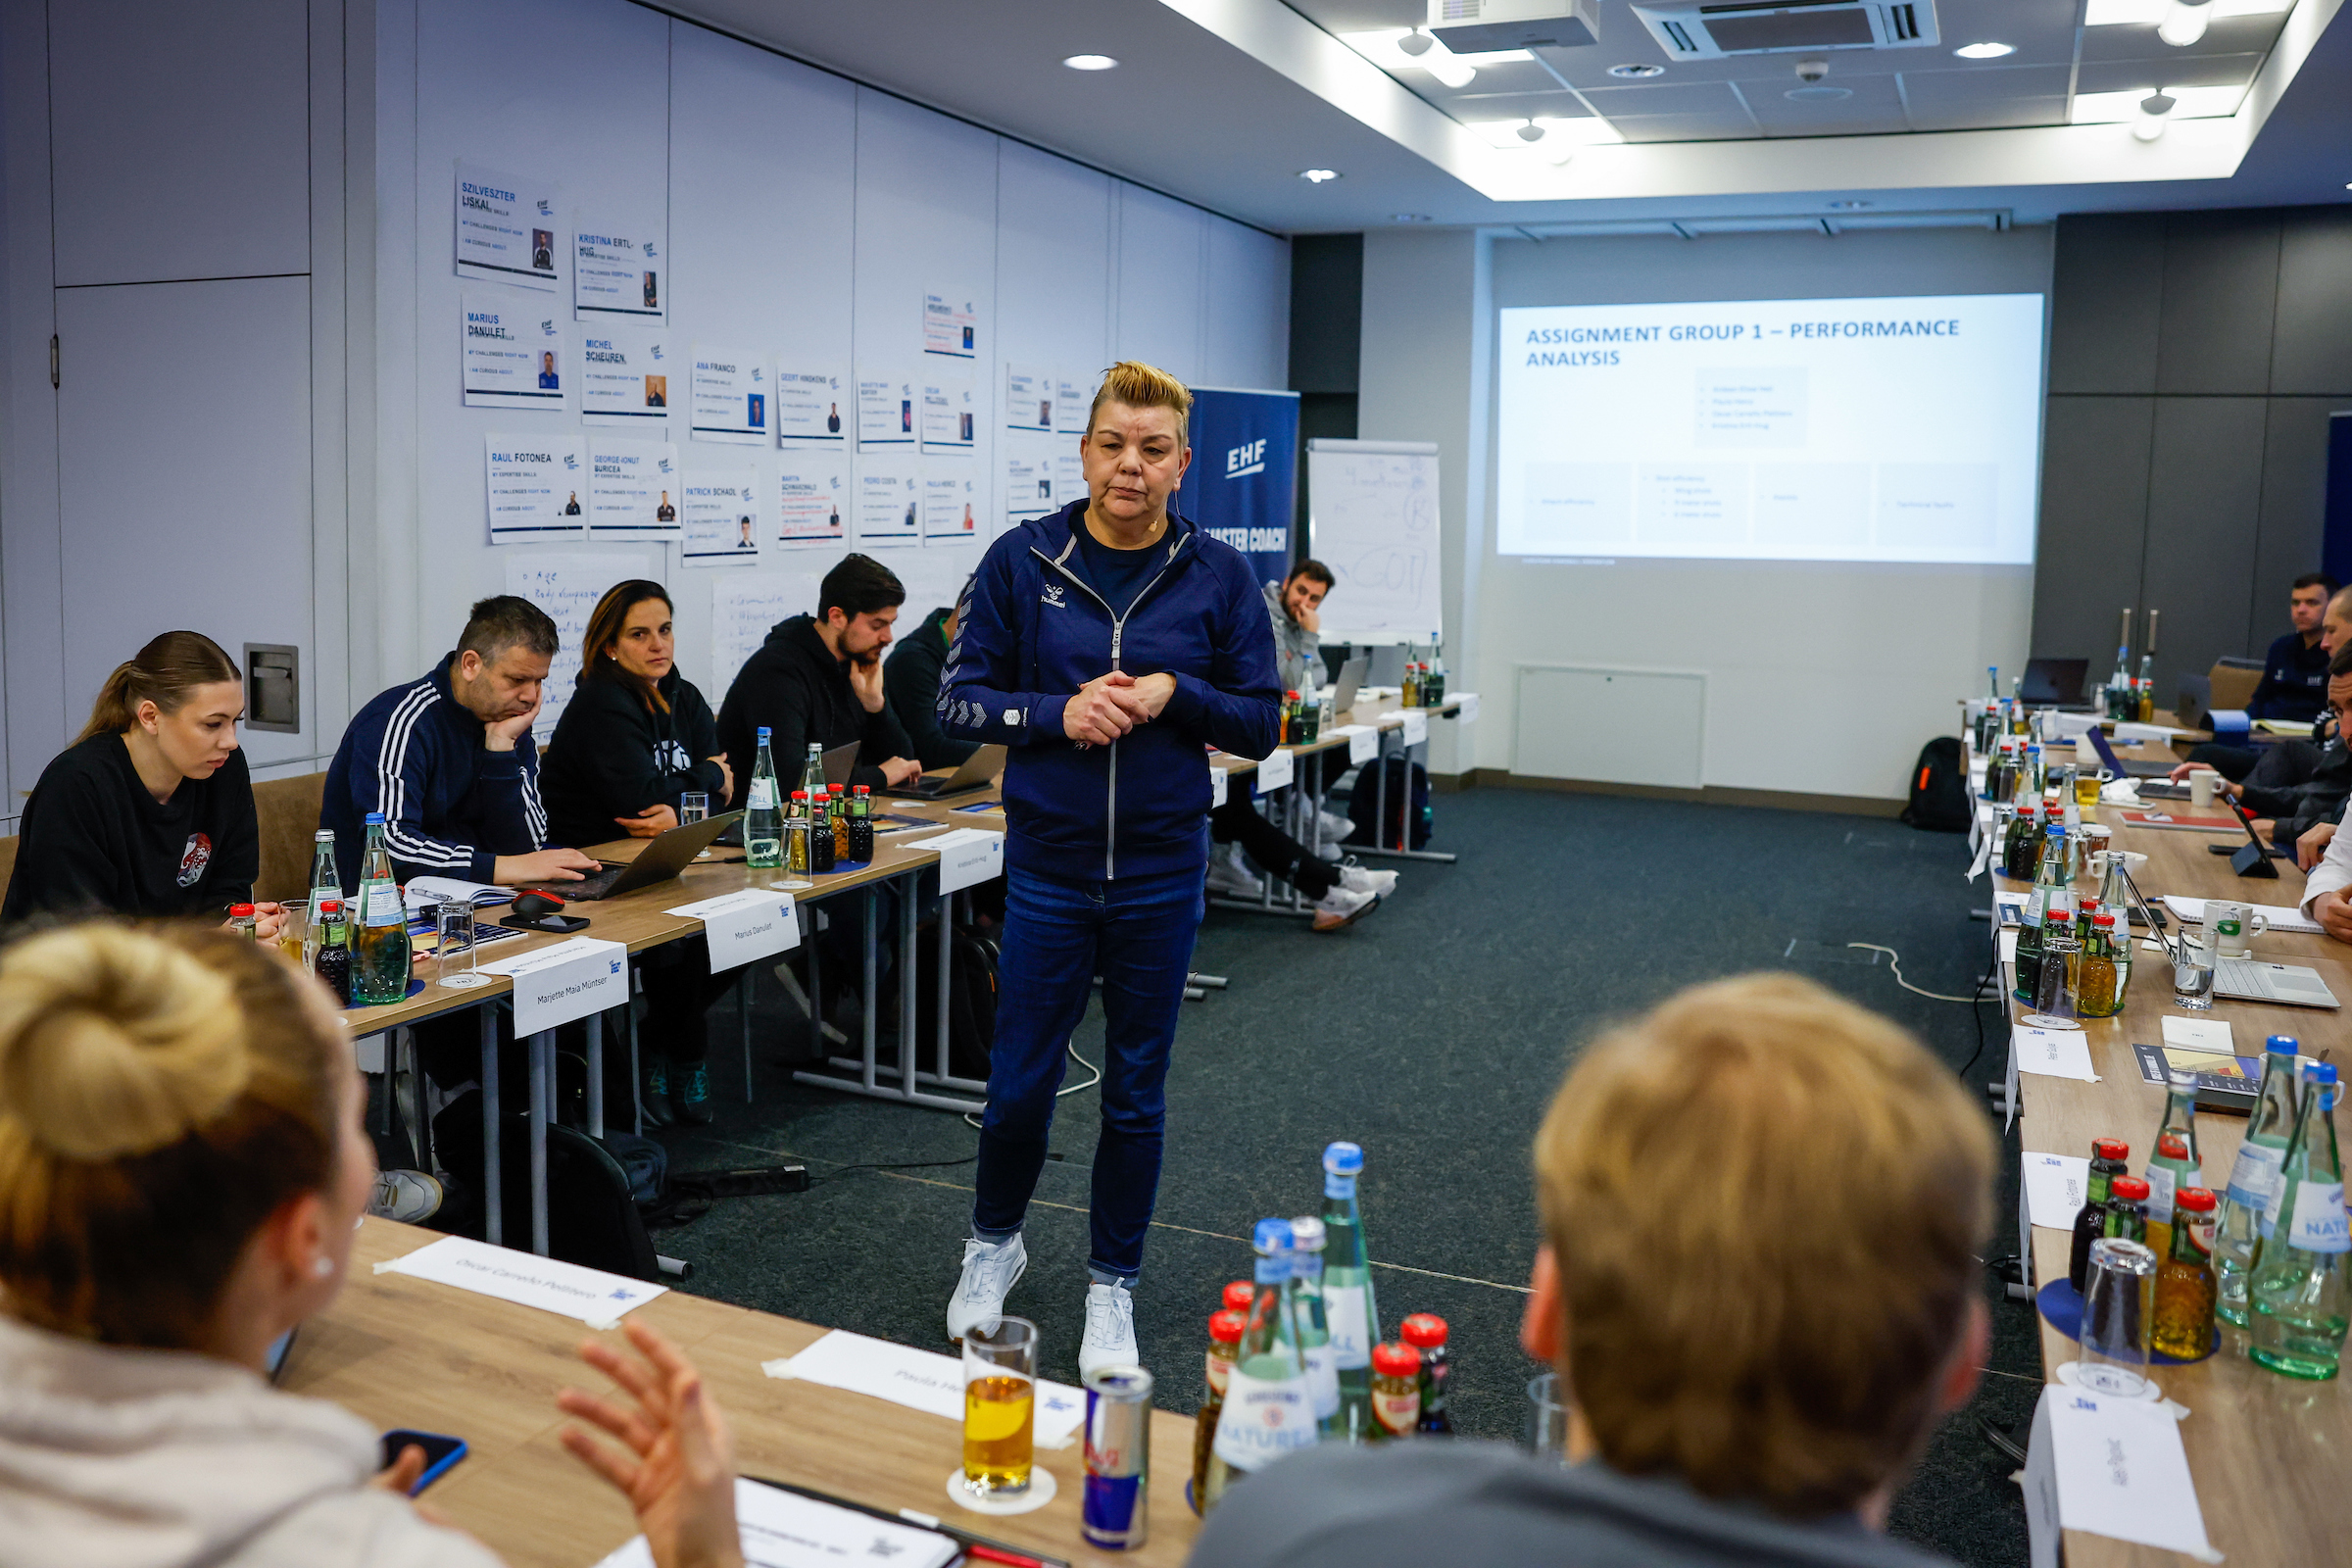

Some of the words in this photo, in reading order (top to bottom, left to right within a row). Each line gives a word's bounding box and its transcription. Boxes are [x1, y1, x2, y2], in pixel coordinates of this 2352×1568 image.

[462, 181, 516, 203] SZILVESZTER
[578, 233, 612, 247] KRISTINA
[612, 238, 634, 249] ERTL-
[467, 312, 499, 324] MARIUS
[467, 324, 506, 338] DANULET
[1527, 325, 1662, 344] ASSIGNMENT
[1669, 323, 1744, 342] GROUP
[1752, 323, 1762, 340] 1
[1789, 318, 1961, 339] PERFORMANCE
[585, 338, 613, 350] MICHEL
[585, 351, 625, 363] SCHEUREN
[1526, 349, 1621, 368] ANALYSIS
[710, 362, 736, 373] FRANCO
[491, 452, 513, 463] RAUL
[514, 453, 552, 463] FOTONEA
[1227, 439, 1267, 472] EHF
[594, 465, 621, 473] BURICEA
[1203, 526, 1250, 553] ASTER
[1249, 526, 1288, 553] COACH
[1041, 595, 1066, 609] hummel
[734, 928, 753, 941] Marius
[752, 922, 773, 935] Danulet
[537, 989, 564, 1005] Marjette
[564, 984, 581, 997] Maia
[581, 976, 608, 991] Müntser
[894, 1368, 938, 1389] Paula
